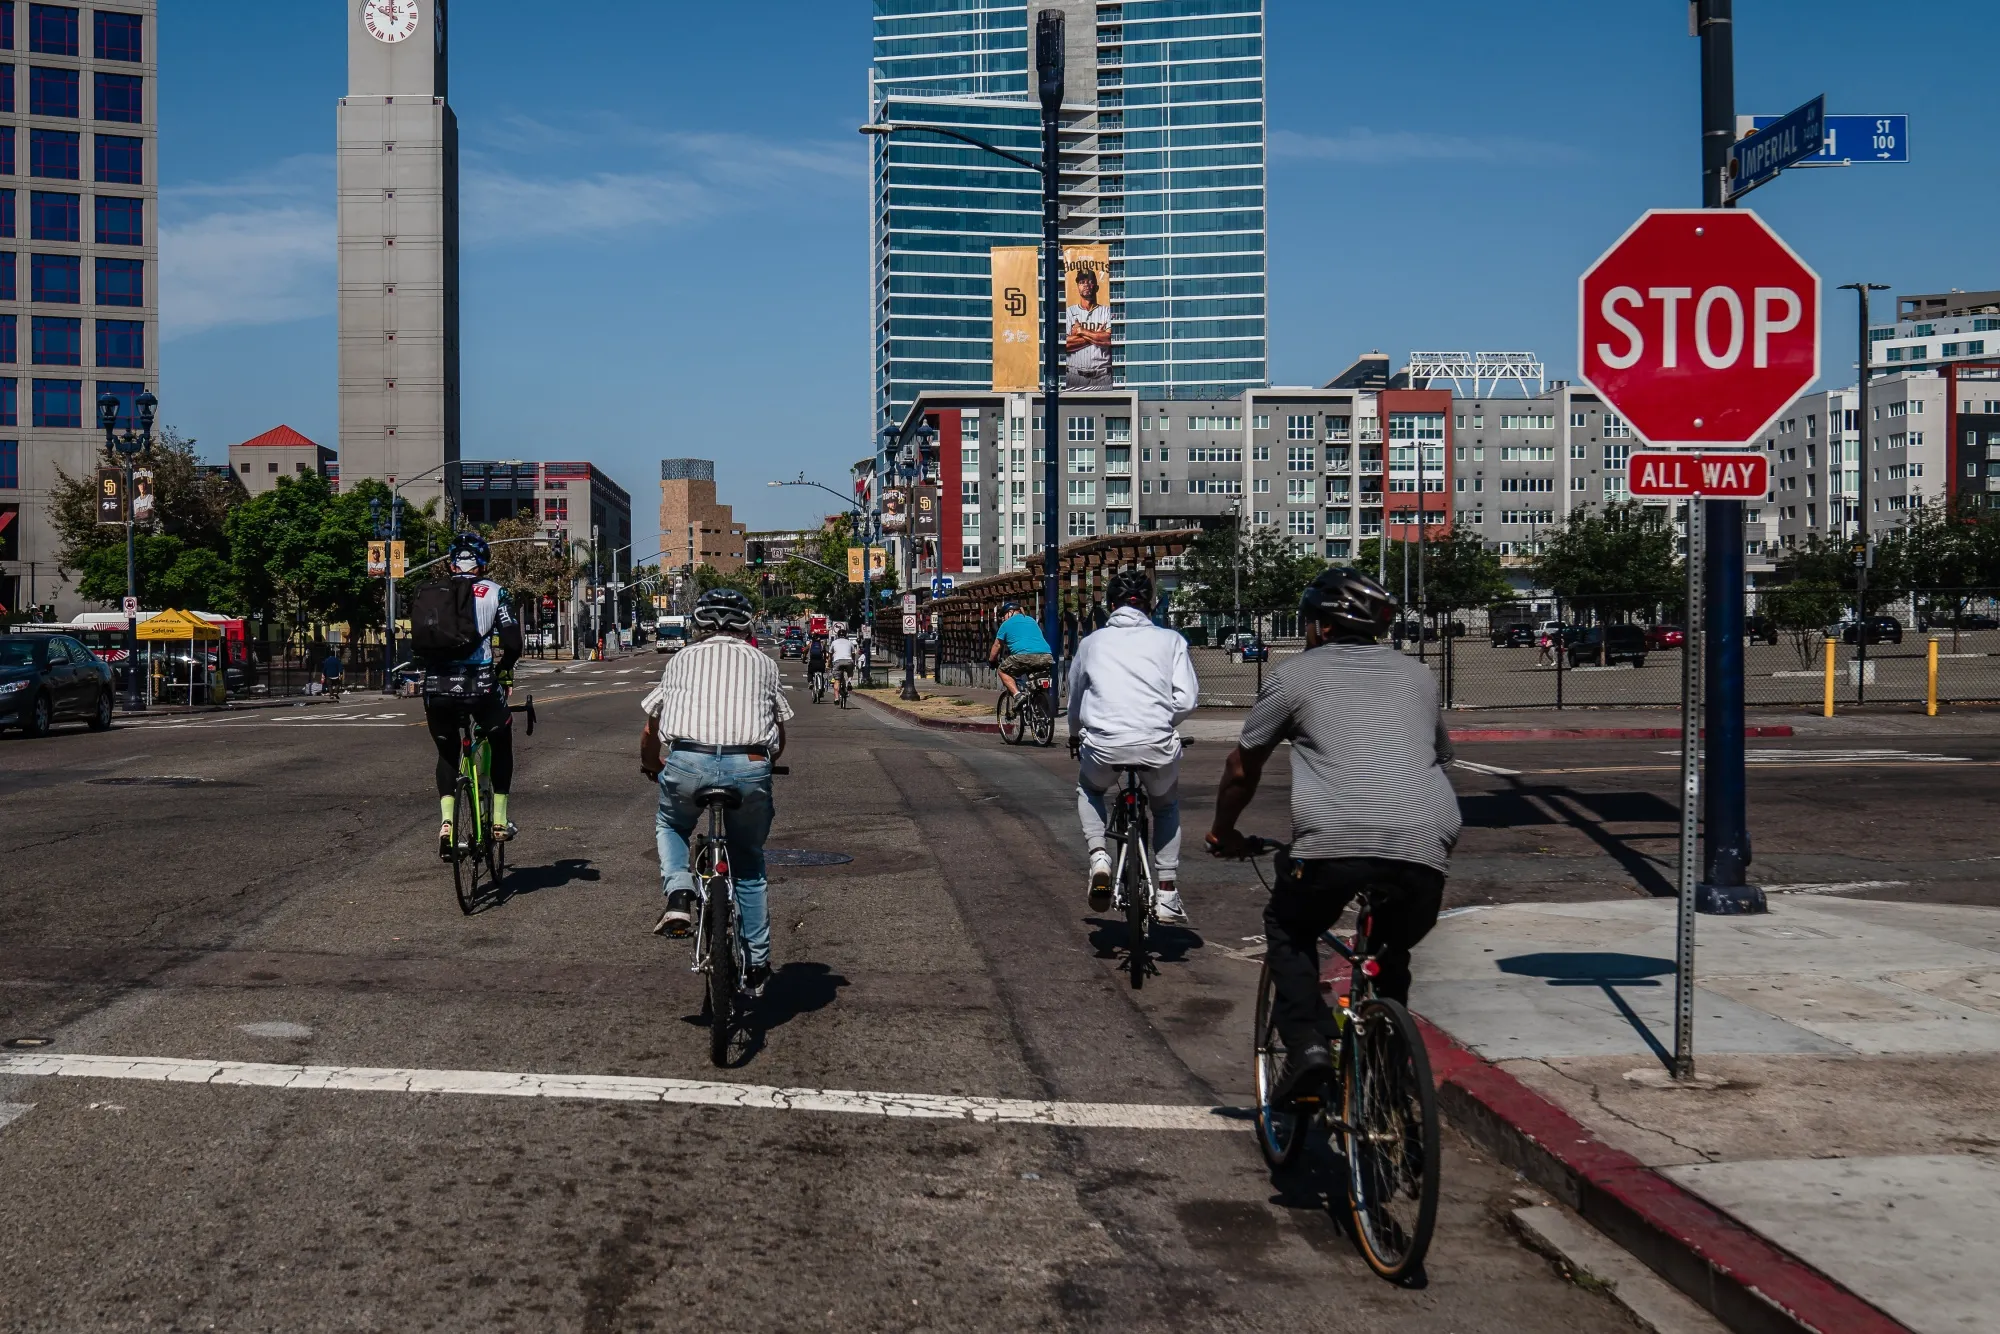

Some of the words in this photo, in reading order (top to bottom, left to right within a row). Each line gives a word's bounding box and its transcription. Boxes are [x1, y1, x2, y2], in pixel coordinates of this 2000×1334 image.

[1876, 120, 1891, 133] ST
[1741, 125, 1798, 179] IMPERIAL
[1819, 129, 1836, 155] H
[1873, 136, 1895, 149] 100
[1597, 285, 1802, 369] STOP
[1640, 462, 1689, 488] ALL
[1701, 462, 1755, 488] WAY
